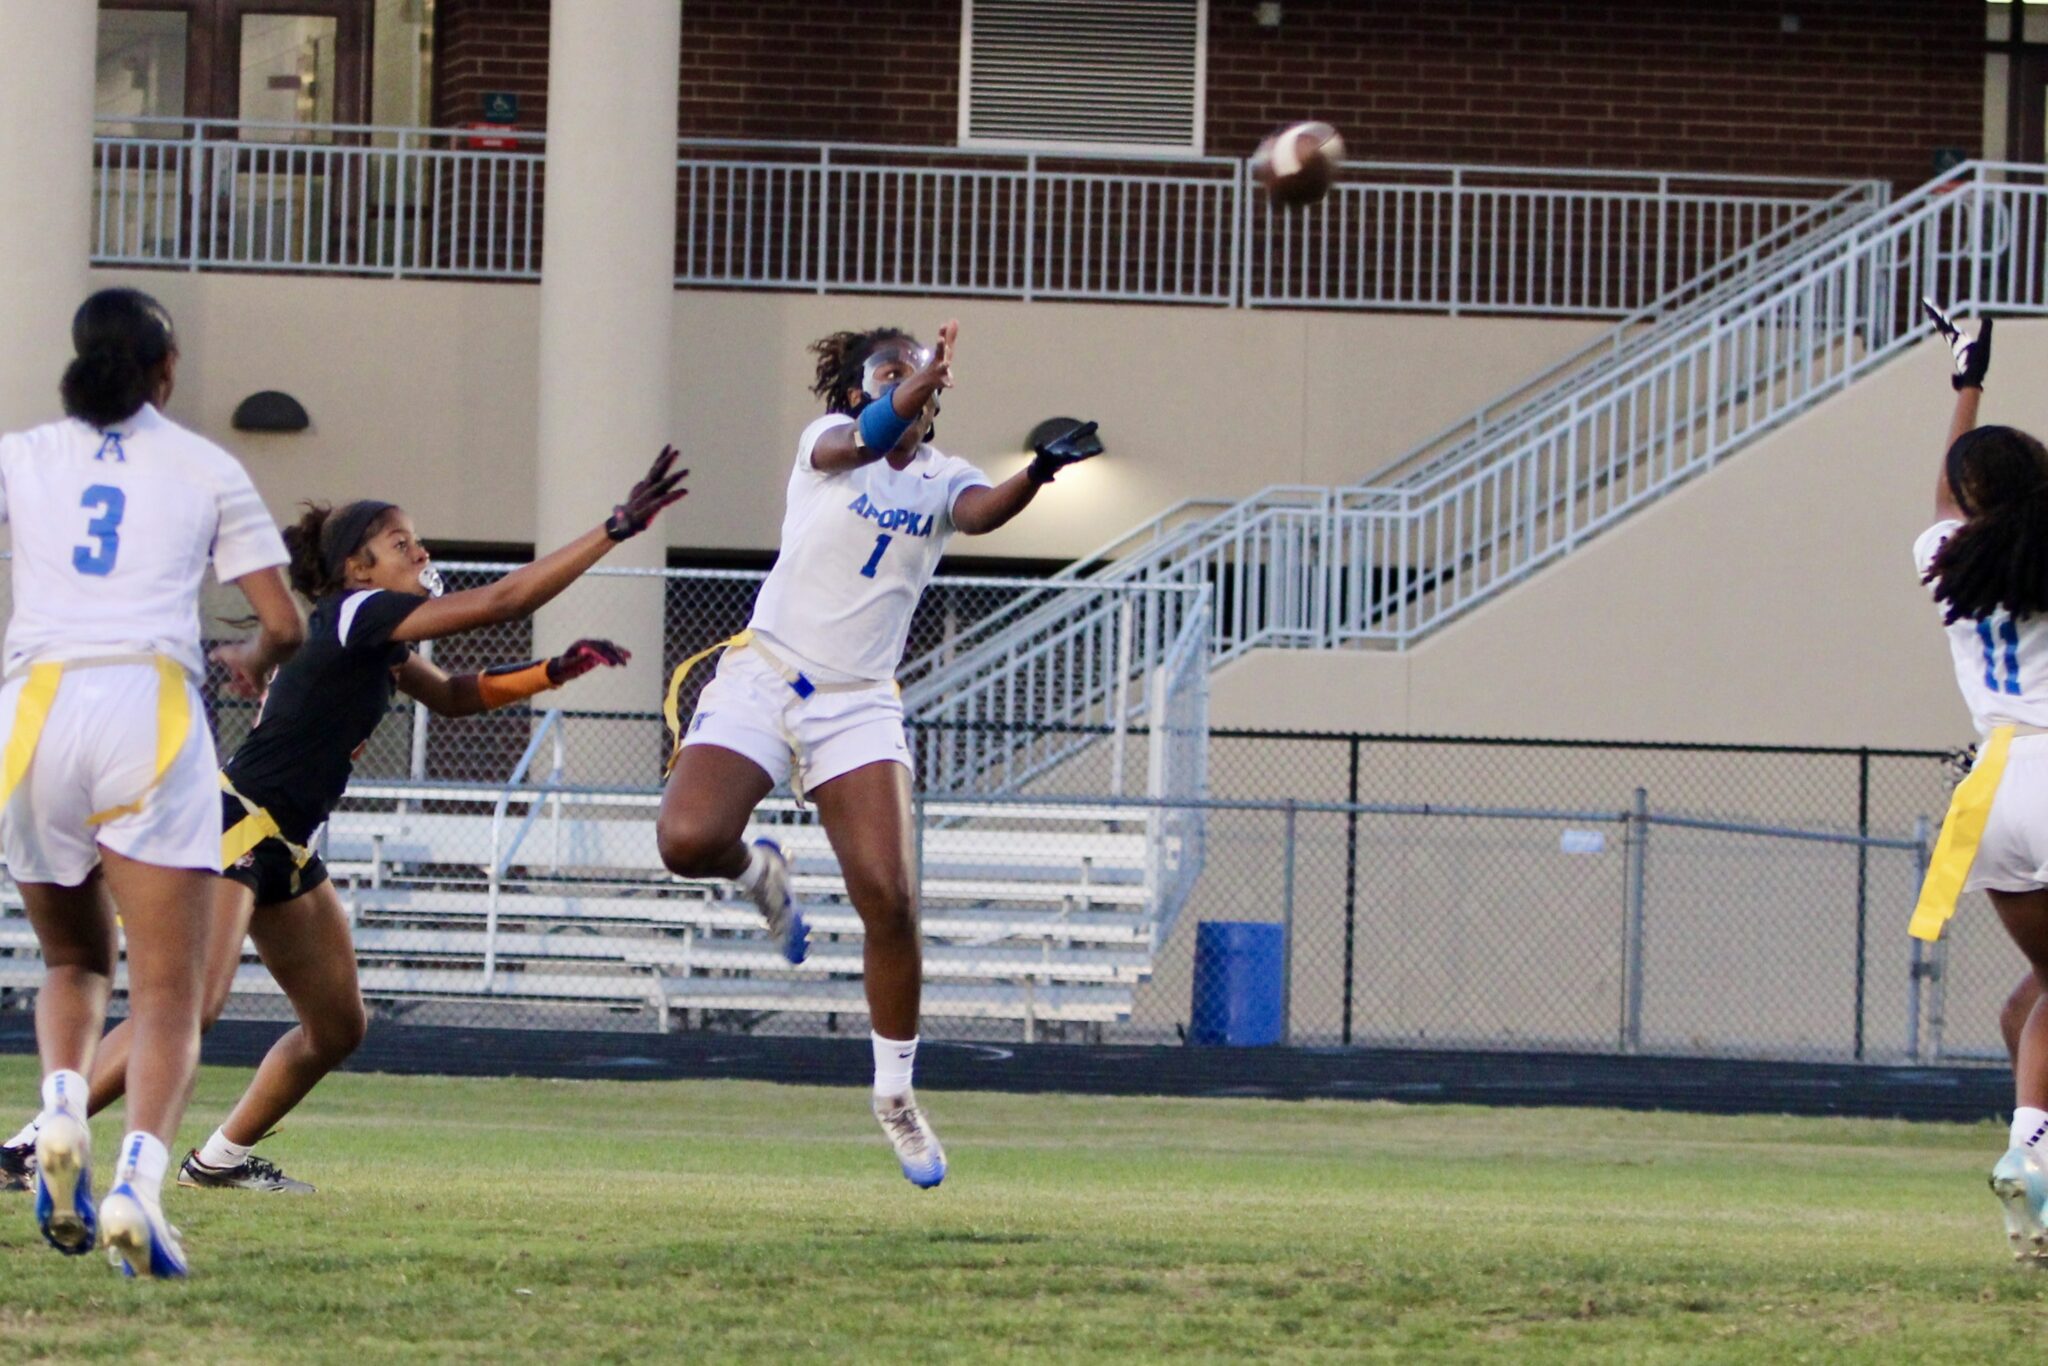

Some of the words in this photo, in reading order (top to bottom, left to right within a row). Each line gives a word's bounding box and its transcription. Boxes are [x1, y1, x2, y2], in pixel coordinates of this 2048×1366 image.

[94, 431, 126, 462] A
[72, 484, 126, 577] 3
[848, 493, 934, 538] APOPKA
[860, 533, 893, 579] 1
[1976, 616, 2022, 696] 11
